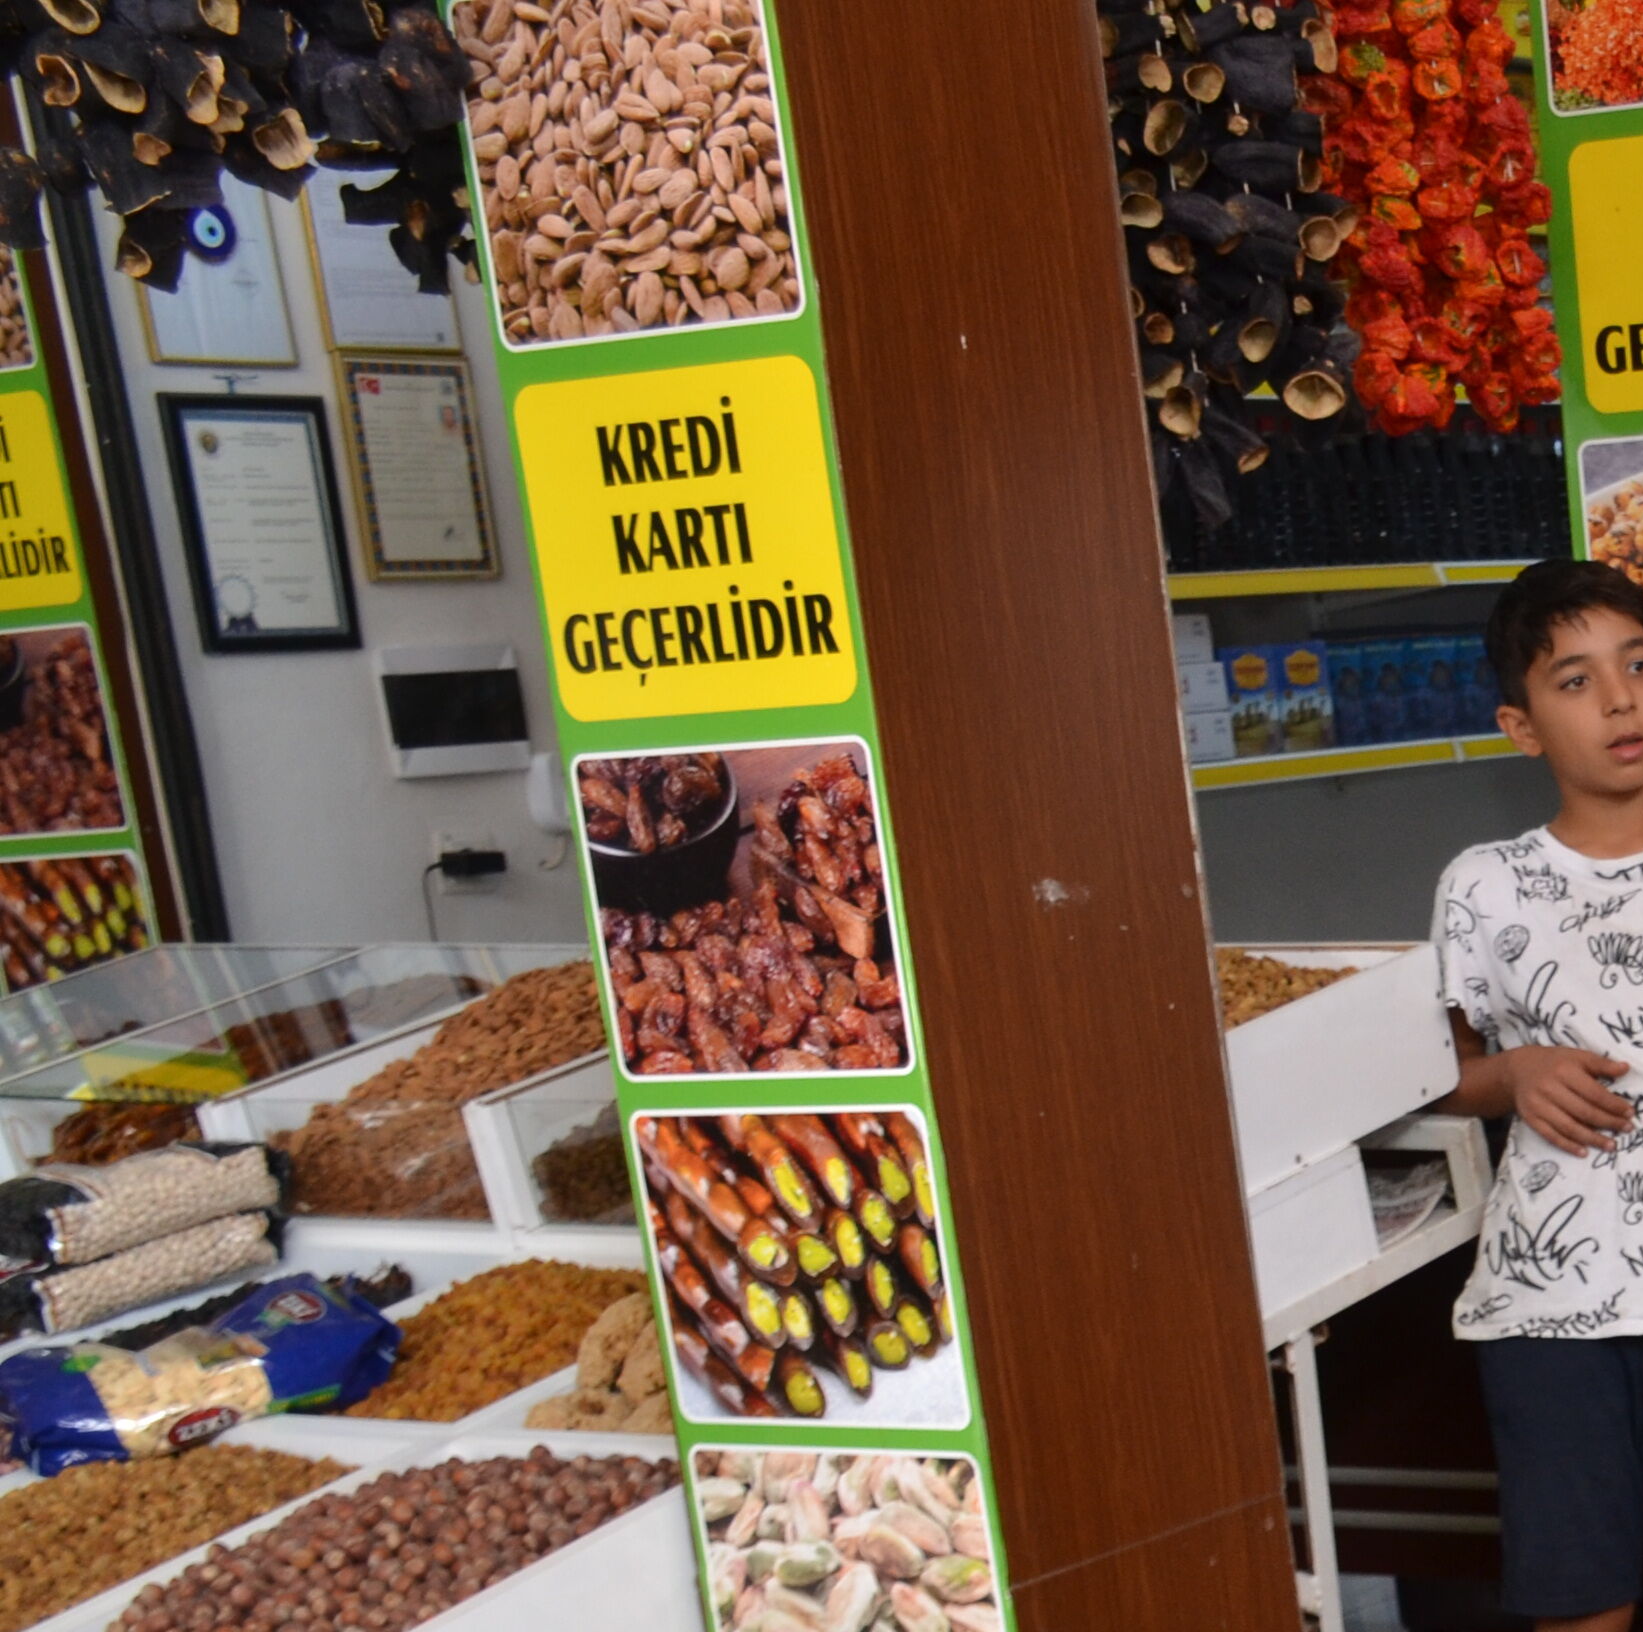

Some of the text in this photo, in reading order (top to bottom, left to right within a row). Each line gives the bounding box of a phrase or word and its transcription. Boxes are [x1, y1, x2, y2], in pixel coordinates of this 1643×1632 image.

[595, 396, 742, 488] KREDİ
[0, 527, 71, 580] LİDİR
[610, 501, 753, 576] KARTI
[564, 578, 842, 688] GEÇERLİDİR
